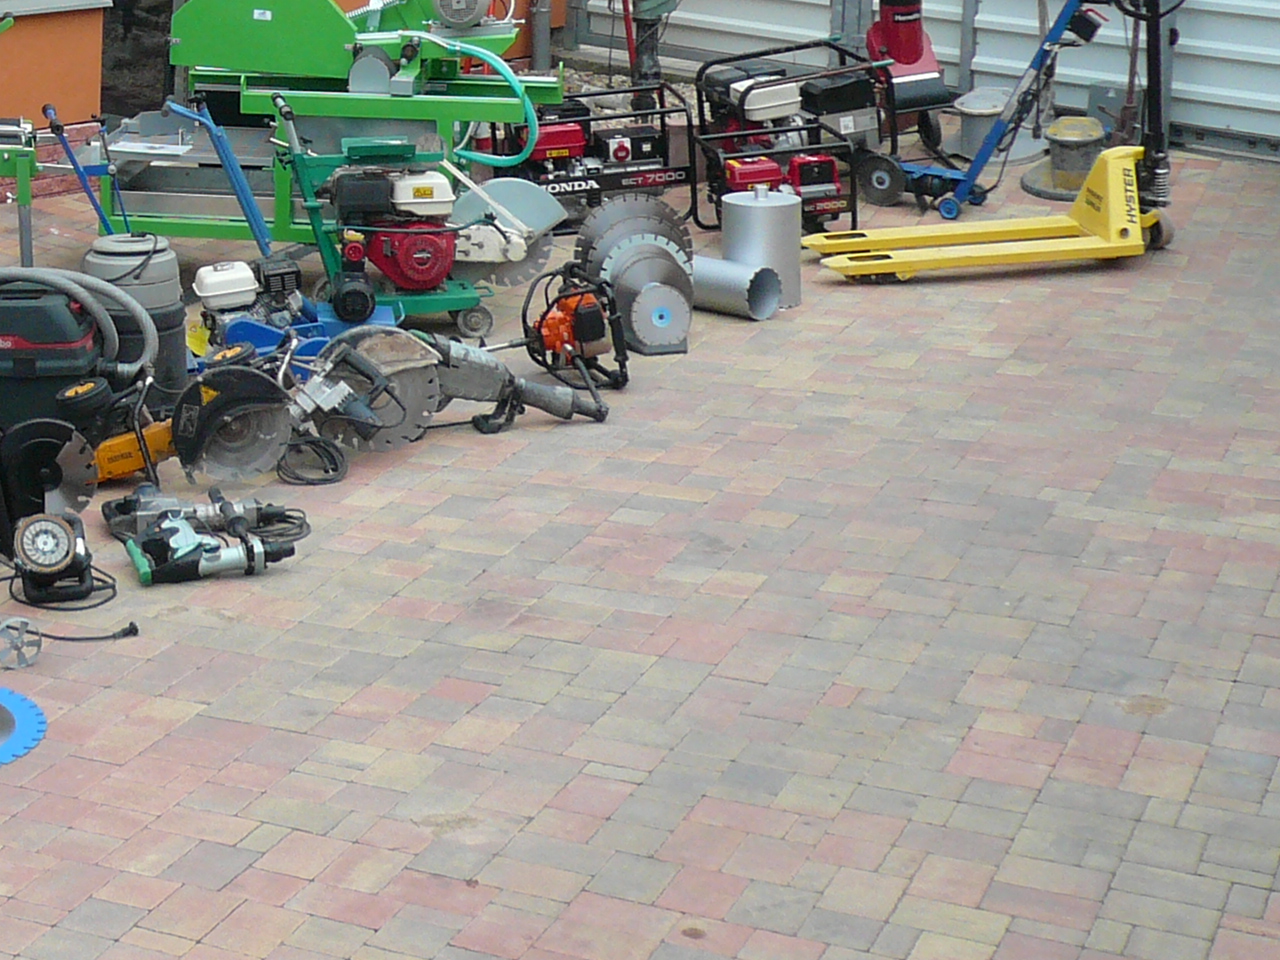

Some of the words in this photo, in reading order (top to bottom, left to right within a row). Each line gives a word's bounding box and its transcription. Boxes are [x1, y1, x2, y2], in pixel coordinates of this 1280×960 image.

[621, 176, 644, 187] ECT
[646, 171, 686, 183] 7000
[1122, 167, 1138, 224] HYSTER
